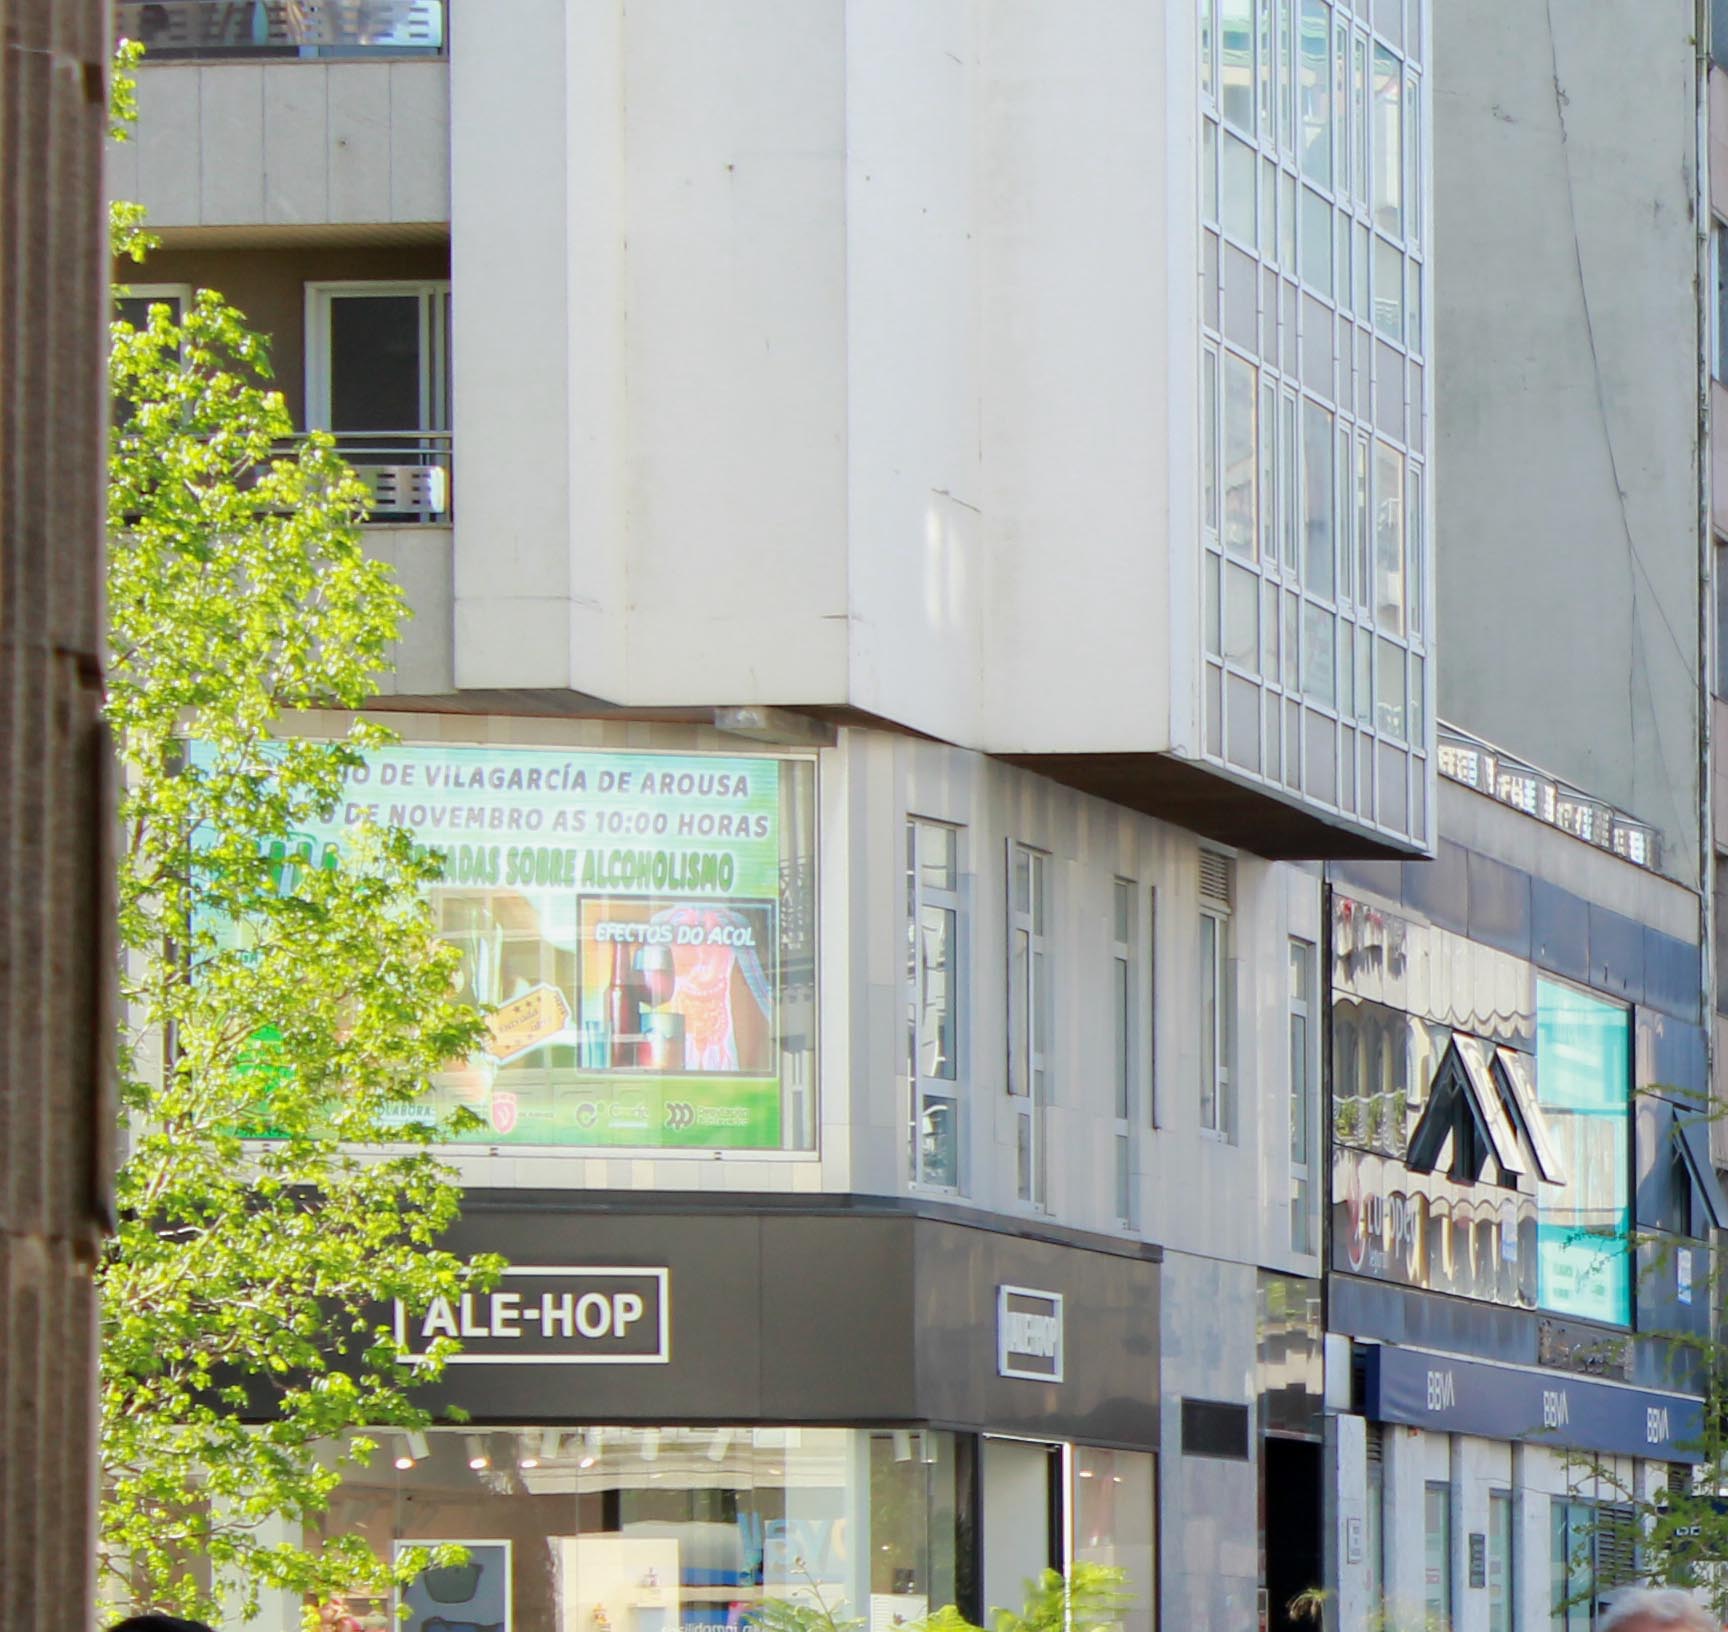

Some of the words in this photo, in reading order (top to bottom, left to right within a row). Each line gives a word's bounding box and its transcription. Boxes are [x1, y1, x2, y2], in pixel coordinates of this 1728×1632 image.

[380, 763, 416, 785] DE
[425, 764, 587, 792] VILAGARCÍA
[598, 771, 632, 792] DE
[641, 772, 748, 797] AROUSA
[389, 804, 544, 831] NOVEMBRO
[552, 810, 585, 832] AS
[595, 811, 668, 834] 10:00
[678, 814, 769, 838] HORAS
[507, 847, 577, 887] SOBRE
[582, 849, 734, 892] ALCOHOLISMO
[595, 922, 673, 944] EFECTOS
[677, 926, 703, 945] DO
[707, 926, 756, 946] ACOL
[421, 1293, 643, 1338] ALE-HOP
[1427, 1371, 1454, 1411] BBVA
[1543, 1389, 1568, 1427] BBVA
[1647, 1406, 1669, 1443] BBVA
